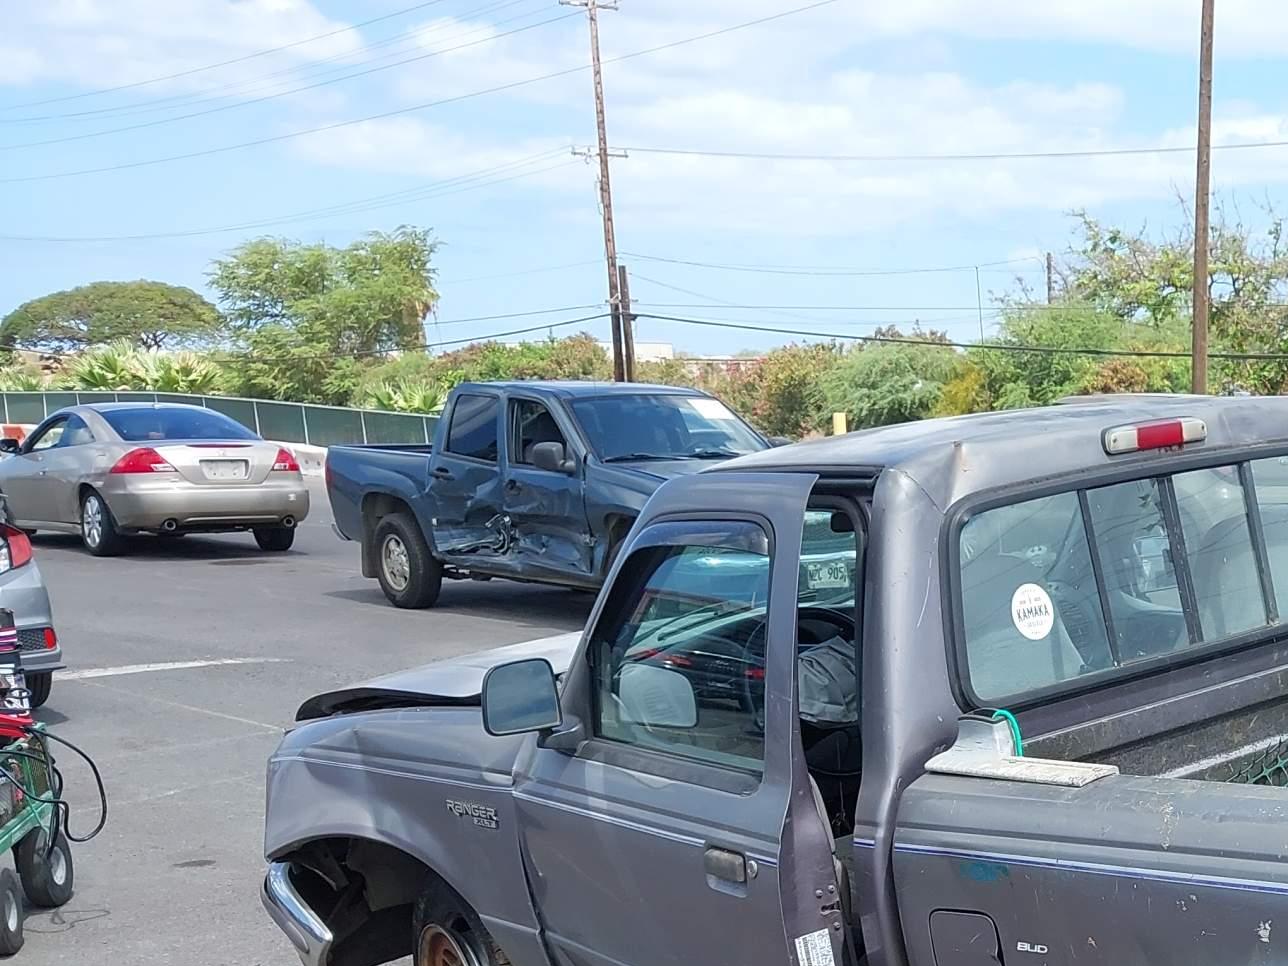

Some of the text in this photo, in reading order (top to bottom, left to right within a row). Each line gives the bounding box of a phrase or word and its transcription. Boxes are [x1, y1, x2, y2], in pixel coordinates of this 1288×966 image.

[1016, 603, 1050, 622] KAMAKA
[445, 799, 497, 820] RANGER
[473, 817, 497, 829] XLT
[1017, 941, 1048, 954] BUD
